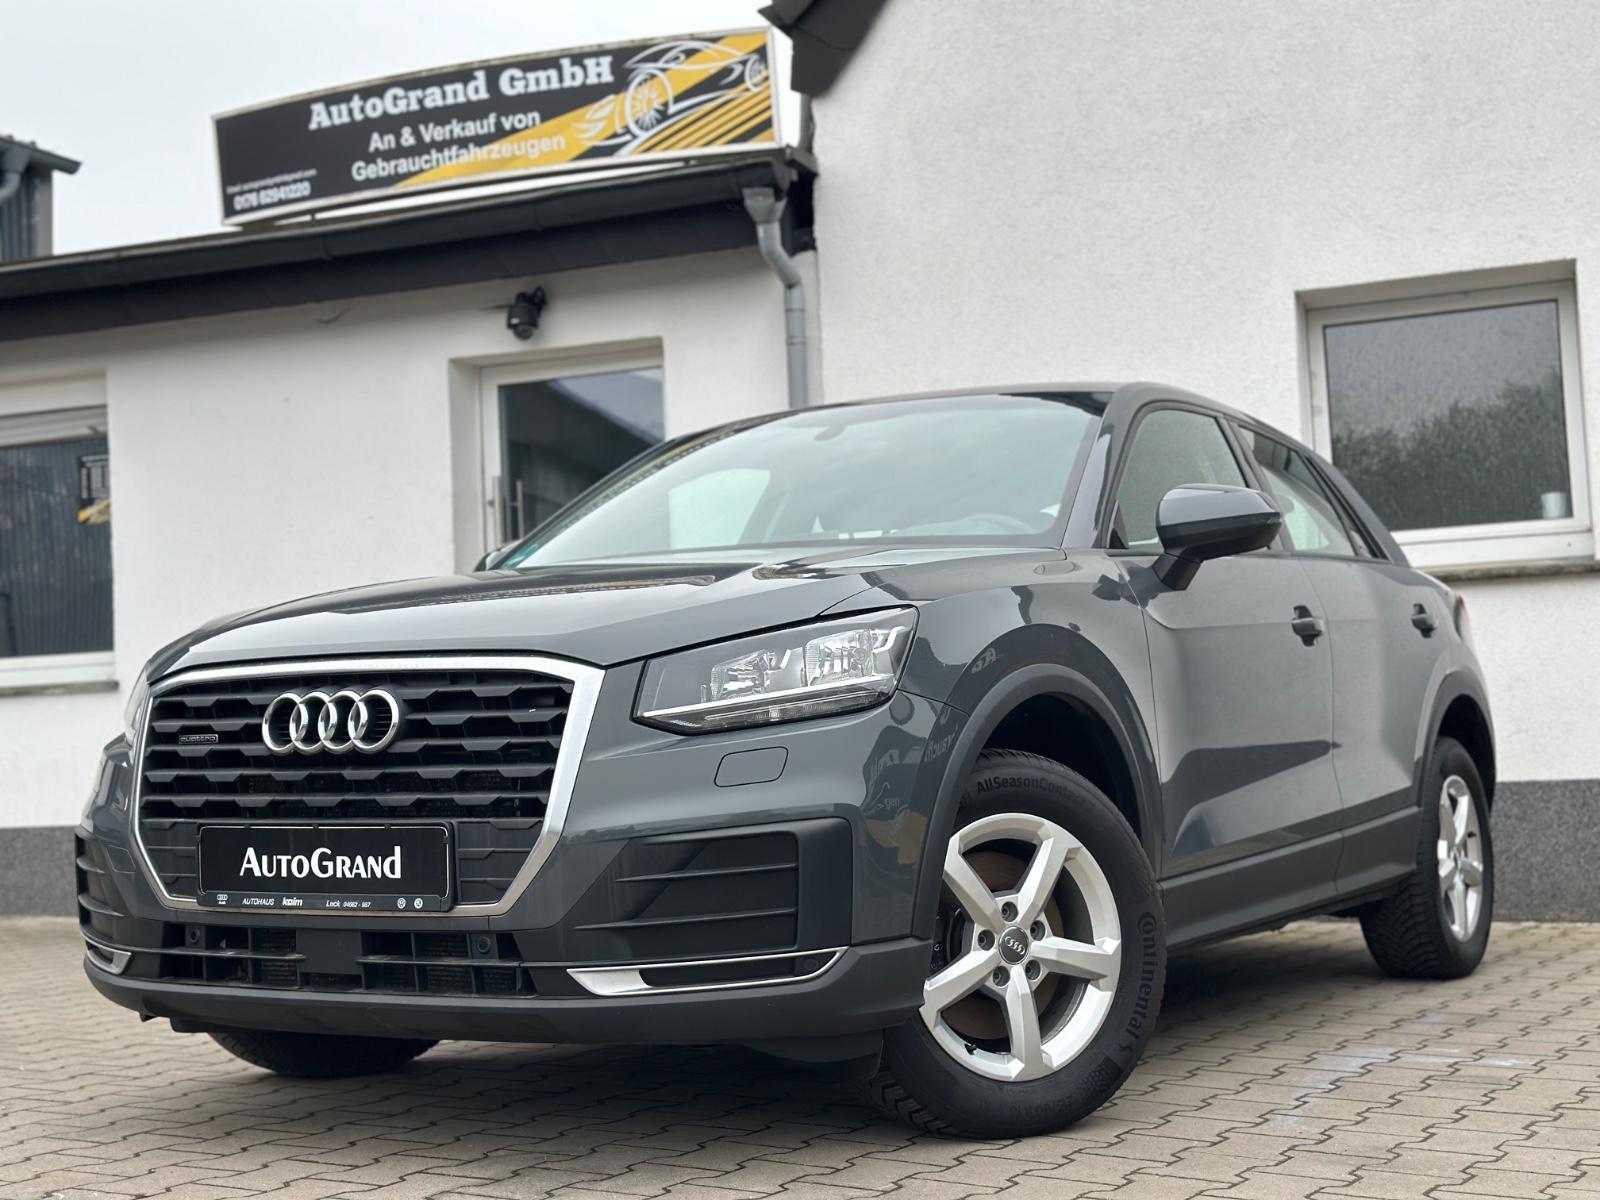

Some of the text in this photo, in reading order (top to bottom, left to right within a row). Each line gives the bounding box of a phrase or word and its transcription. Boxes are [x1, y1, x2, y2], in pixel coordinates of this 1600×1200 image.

[308, 55, 615, 130] AutoGrand GmbH
[368, 110, 541, 152] An & Verkauf von
[351, 134, 566, 181] Gebrauchtfahrzeugen
[242, 898, 275, 906] AUTOHAUS
[325, 899, 341, 908] Leck
